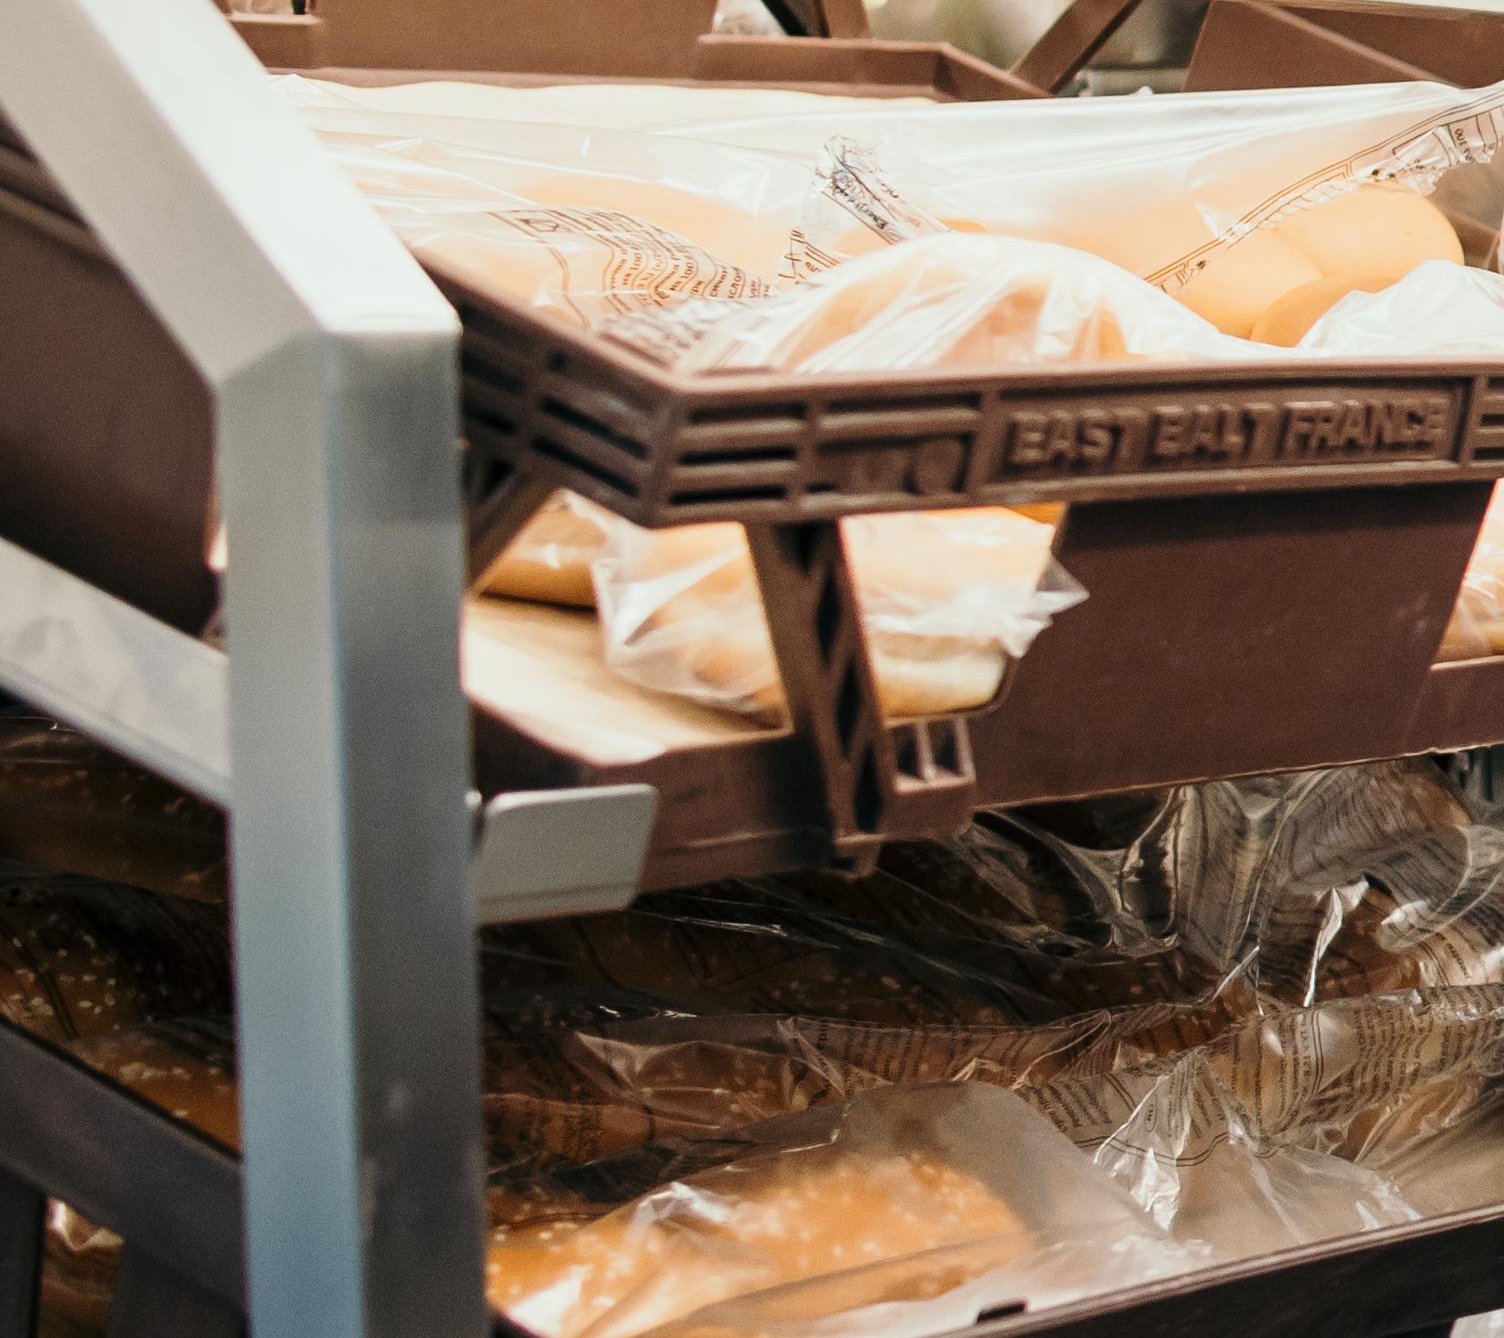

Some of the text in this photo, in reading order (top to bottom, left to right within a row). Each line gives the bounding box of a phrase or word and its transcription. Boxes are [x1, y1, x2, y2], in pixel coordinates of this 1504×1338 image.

[1003, 399, 1451, 463] EAST BALT FRANCE
